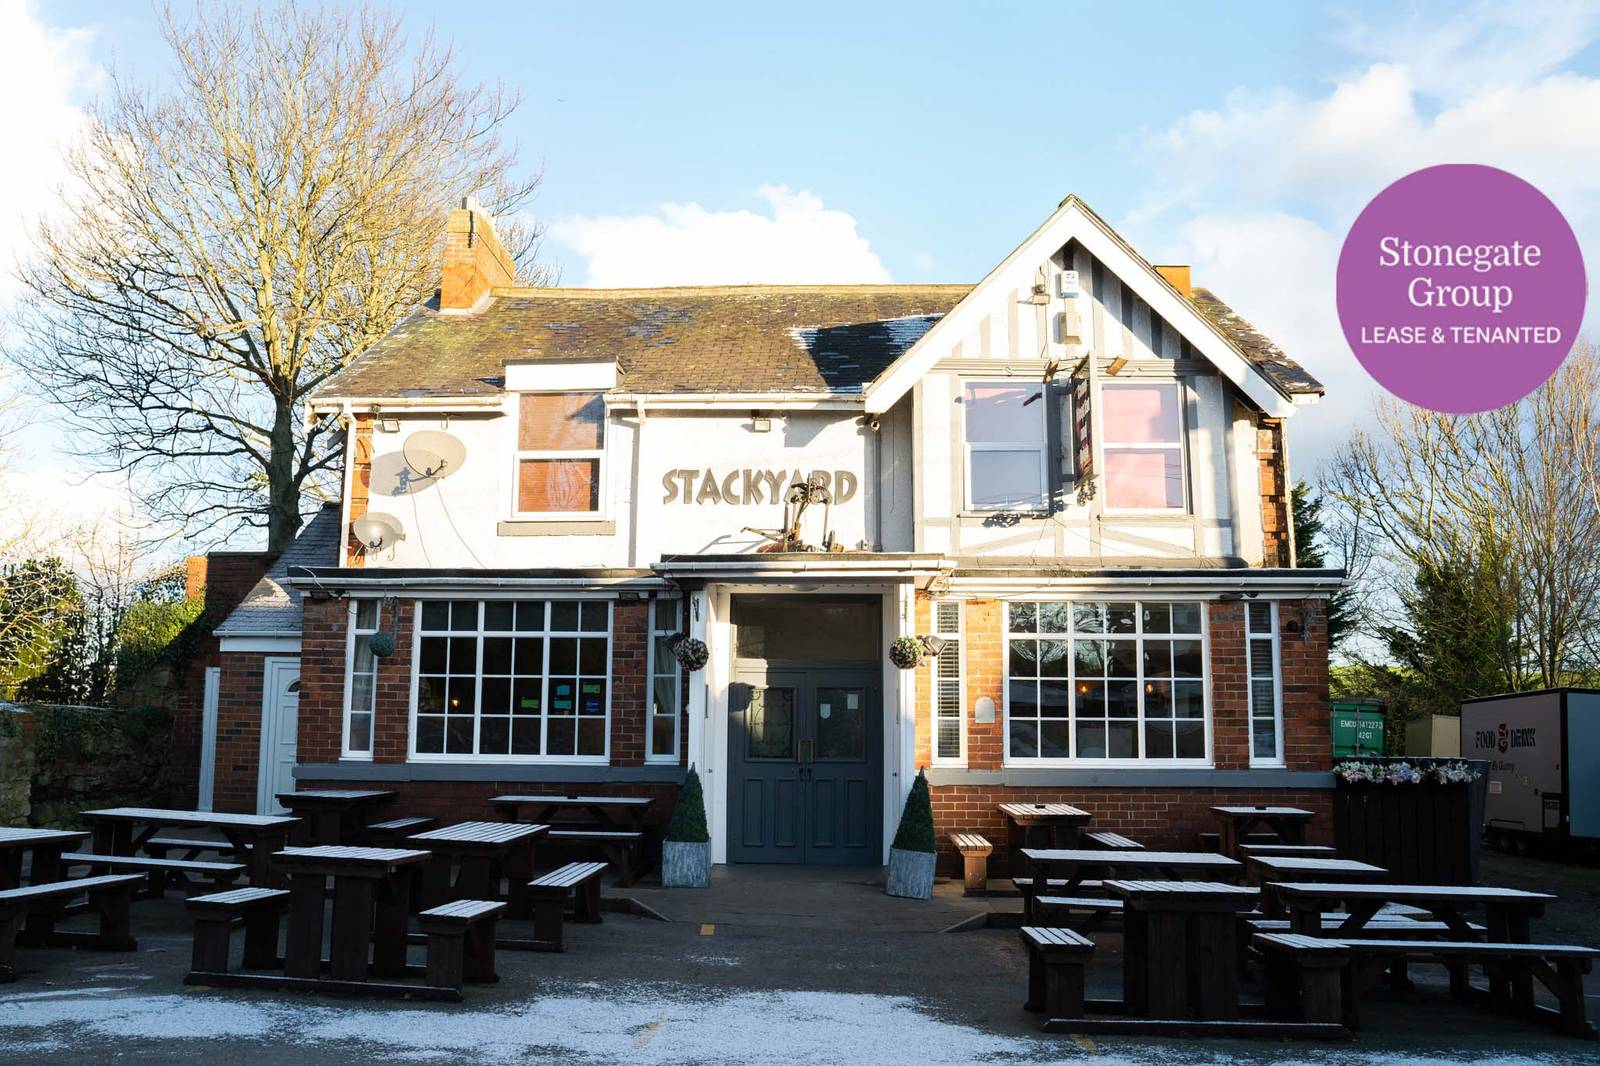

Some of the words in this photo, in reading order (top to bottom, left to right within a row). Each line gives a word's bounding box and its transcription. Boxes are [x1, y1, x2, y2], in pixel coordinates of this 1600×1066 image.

[662, 467, 858, 506] STACKYARD
[1475, 730, 1496, 749] FOOD
[1510, 727, 1536, 748] DRINK
